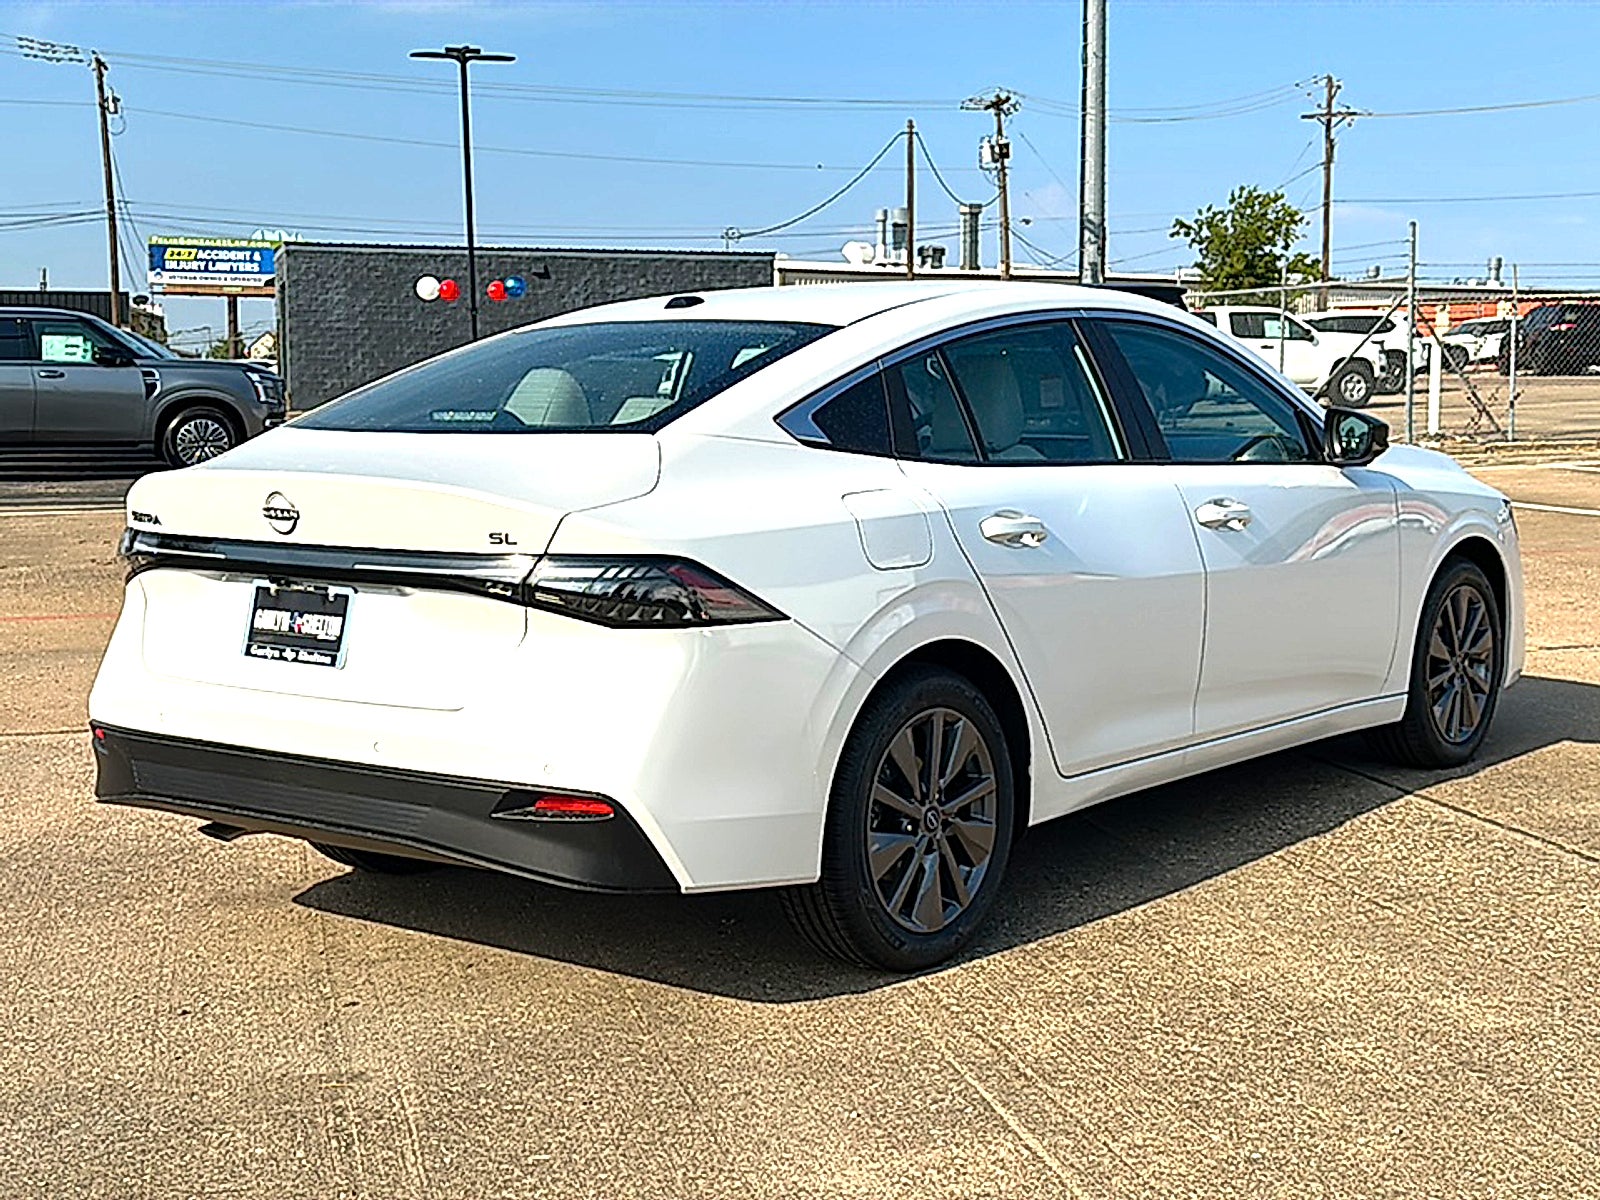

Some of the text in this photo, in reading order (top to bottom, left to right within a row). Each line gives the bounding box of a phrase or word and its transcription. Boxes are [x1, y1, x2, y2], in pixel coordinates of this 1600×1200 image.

[168, 249, 261, 261] 24/7 ACCIDENT &
[164, 260, 260, 272] INJURY LAWYERS
[262, 507, 300, 521] NISSAN
[488, 532, 518, 546] SL
